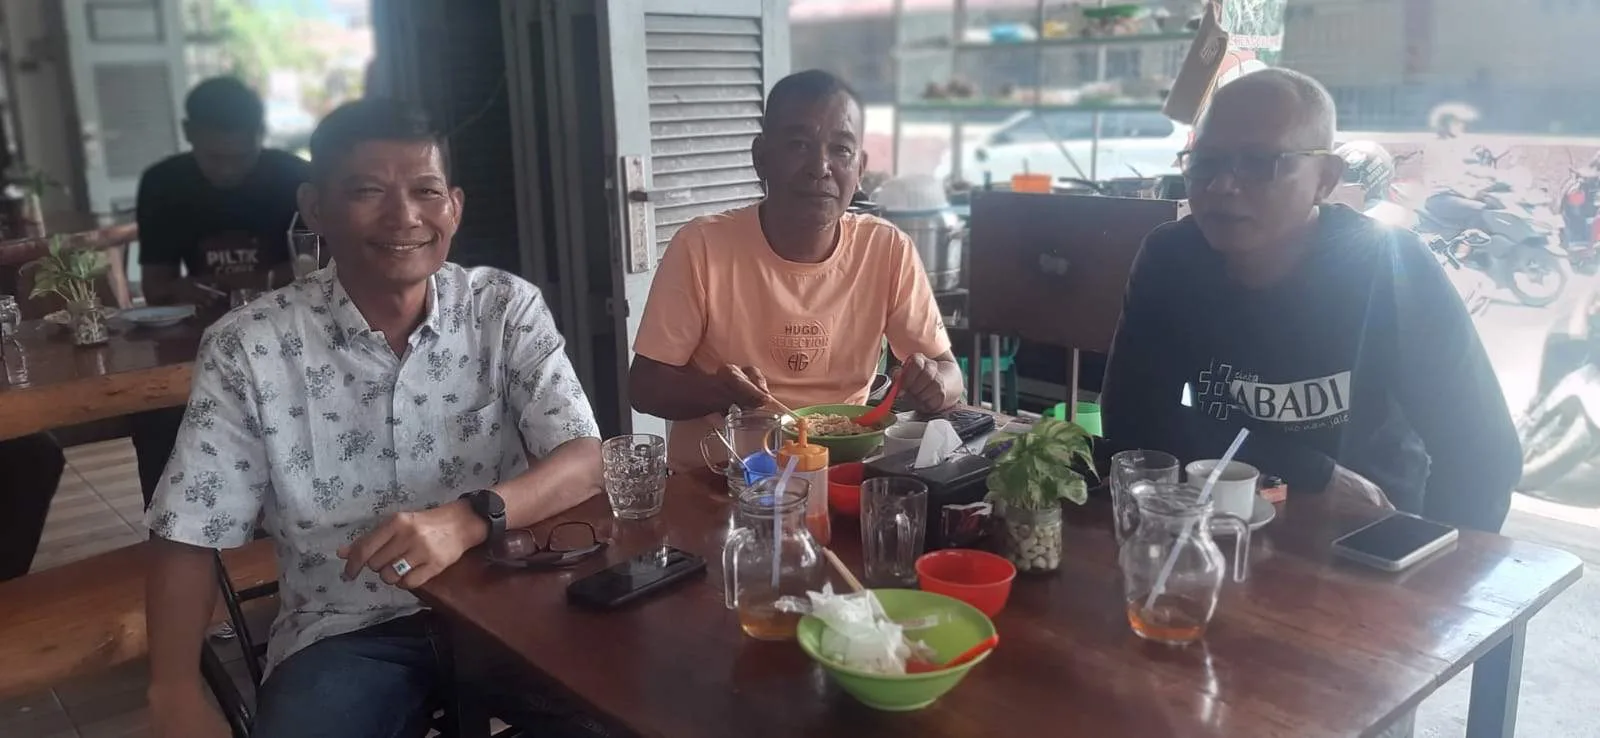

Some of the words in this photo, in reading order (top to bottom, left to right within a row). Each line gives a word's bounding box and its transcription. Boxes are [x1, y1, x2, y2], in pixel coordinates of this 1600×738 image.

[784, 324, 820, 335] HUGO
[769, 335, 832, 347] SELECTION
[1235, 377, 1345, 419] ABADI
